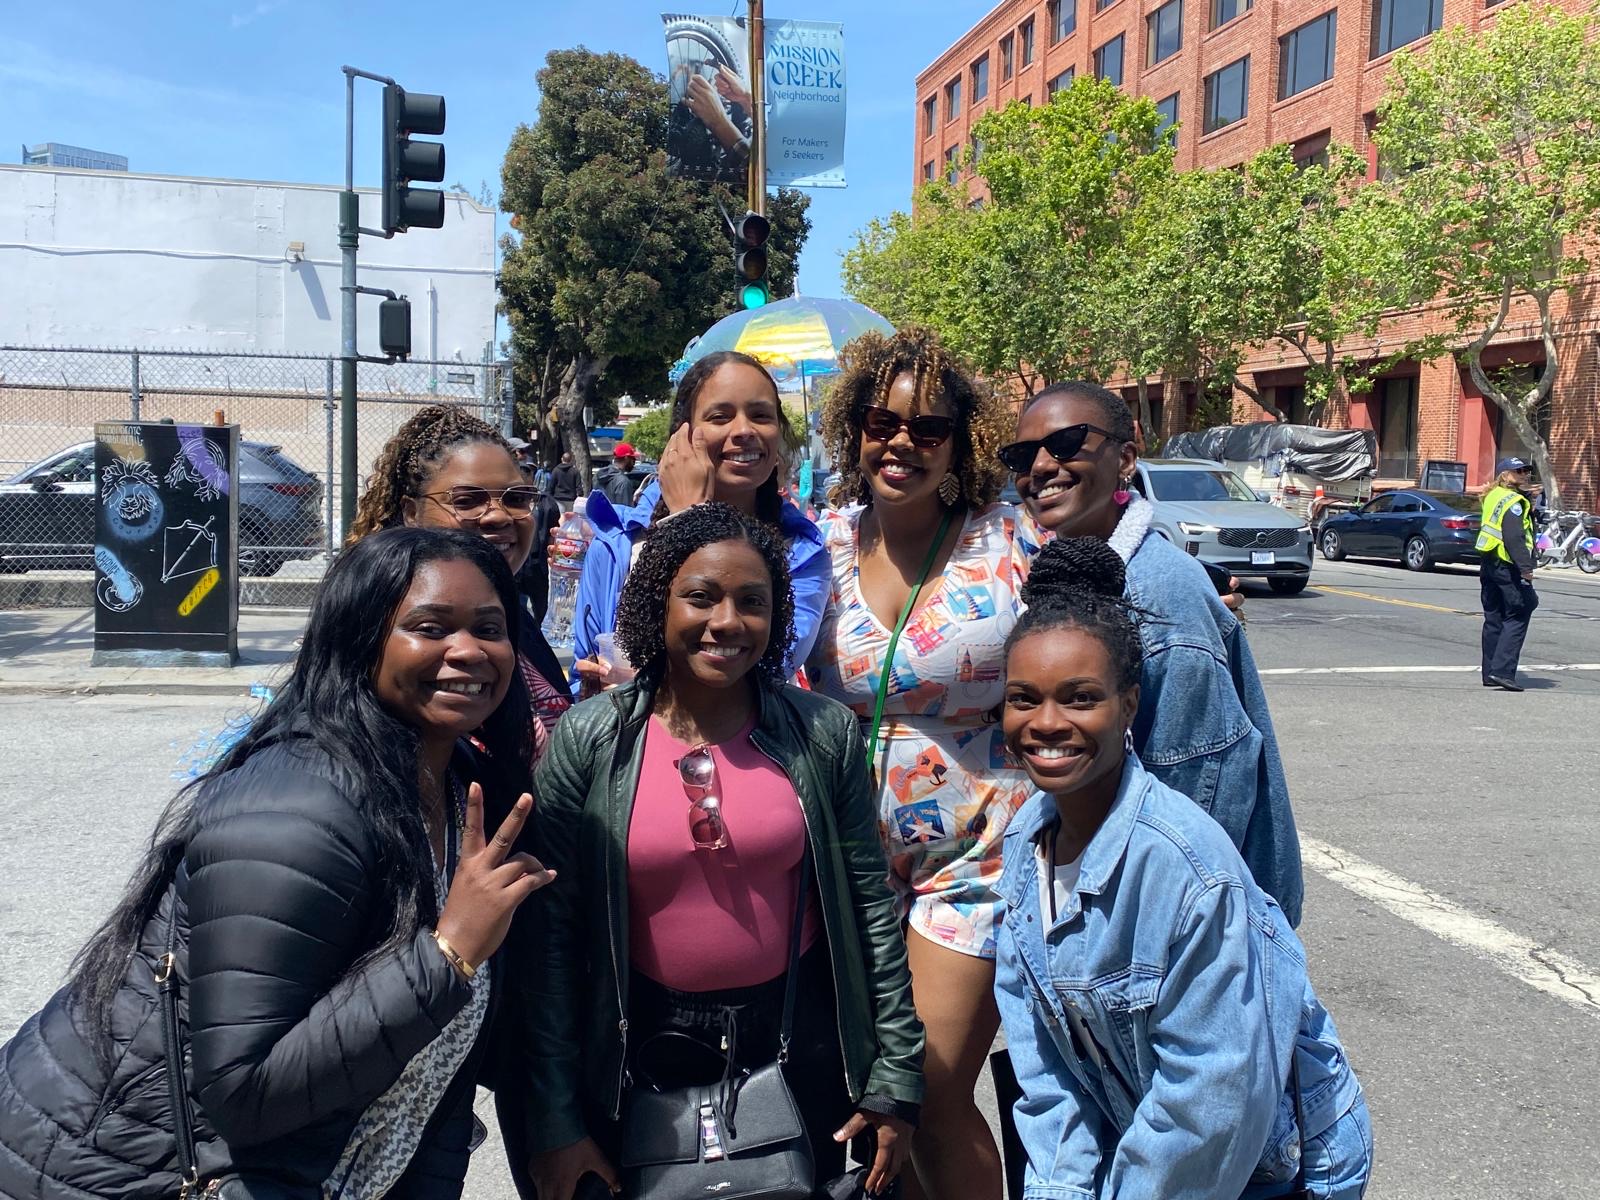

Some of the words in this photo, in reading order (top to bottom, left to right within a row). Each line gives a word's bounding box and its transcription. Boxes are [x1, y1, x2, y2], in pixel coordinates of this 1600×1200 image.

[770, 45, 841, 68] MISSION
[771, 61, 842, 89] CREEK
[773, 90, 840, 103] Neighborhood
[782, 137, 796, 146] For
[798, 138, 829, 147] Makers
[792, 151, 824, 160] Seekers
